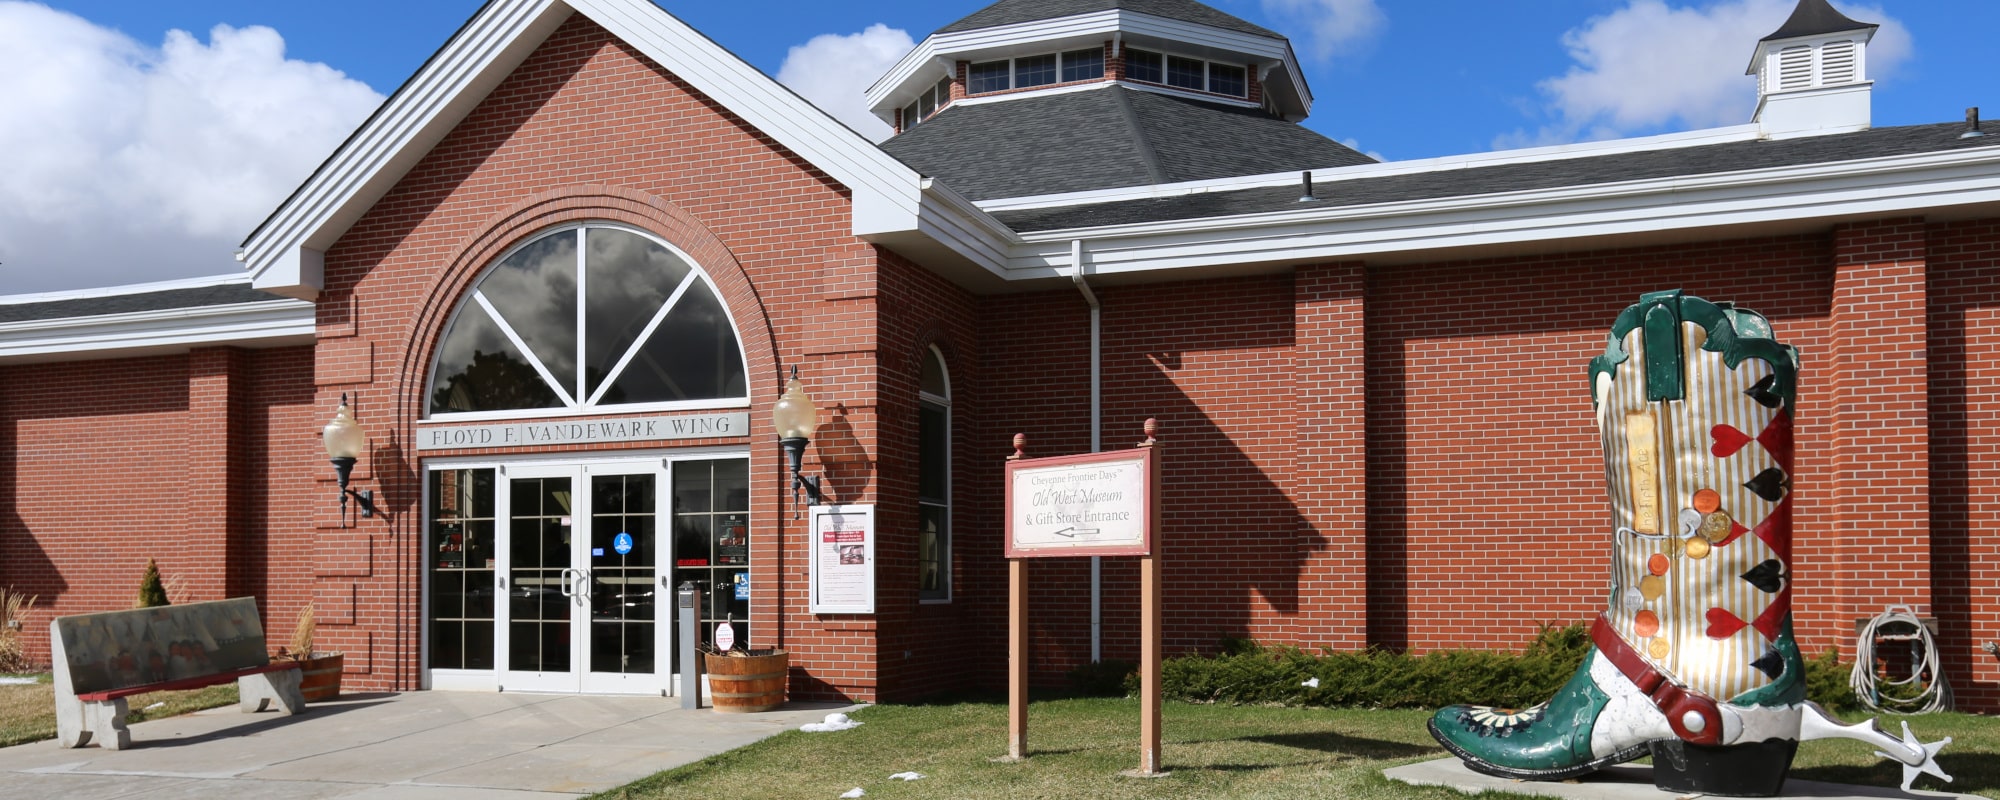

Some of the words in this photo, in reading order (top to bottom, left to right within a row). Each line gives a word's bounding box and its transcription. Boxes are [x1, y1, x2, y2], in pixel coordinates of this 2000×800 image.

[432, 429, 492, 446] FLOYD
[504, 427, 518, 443] F.
[528, 420, 657, 441] VANDEWARK
[671, 416, 731, 435] WING
[1031, 475, 1066, 487] Cheyenne
[1067, 472, 1097, 482] Frontier
[1032, 488, 1052, 507] Old
[1052, 489, 1077, 505] West
[1080, 488, 1122, 504] Museum
[1025, 514, 1033, 526] &
[1036, 512, 1053, 525] Gift
[1056, 511, 1081, 524] Store
[1084, 510, 1129, 523] Entrance
